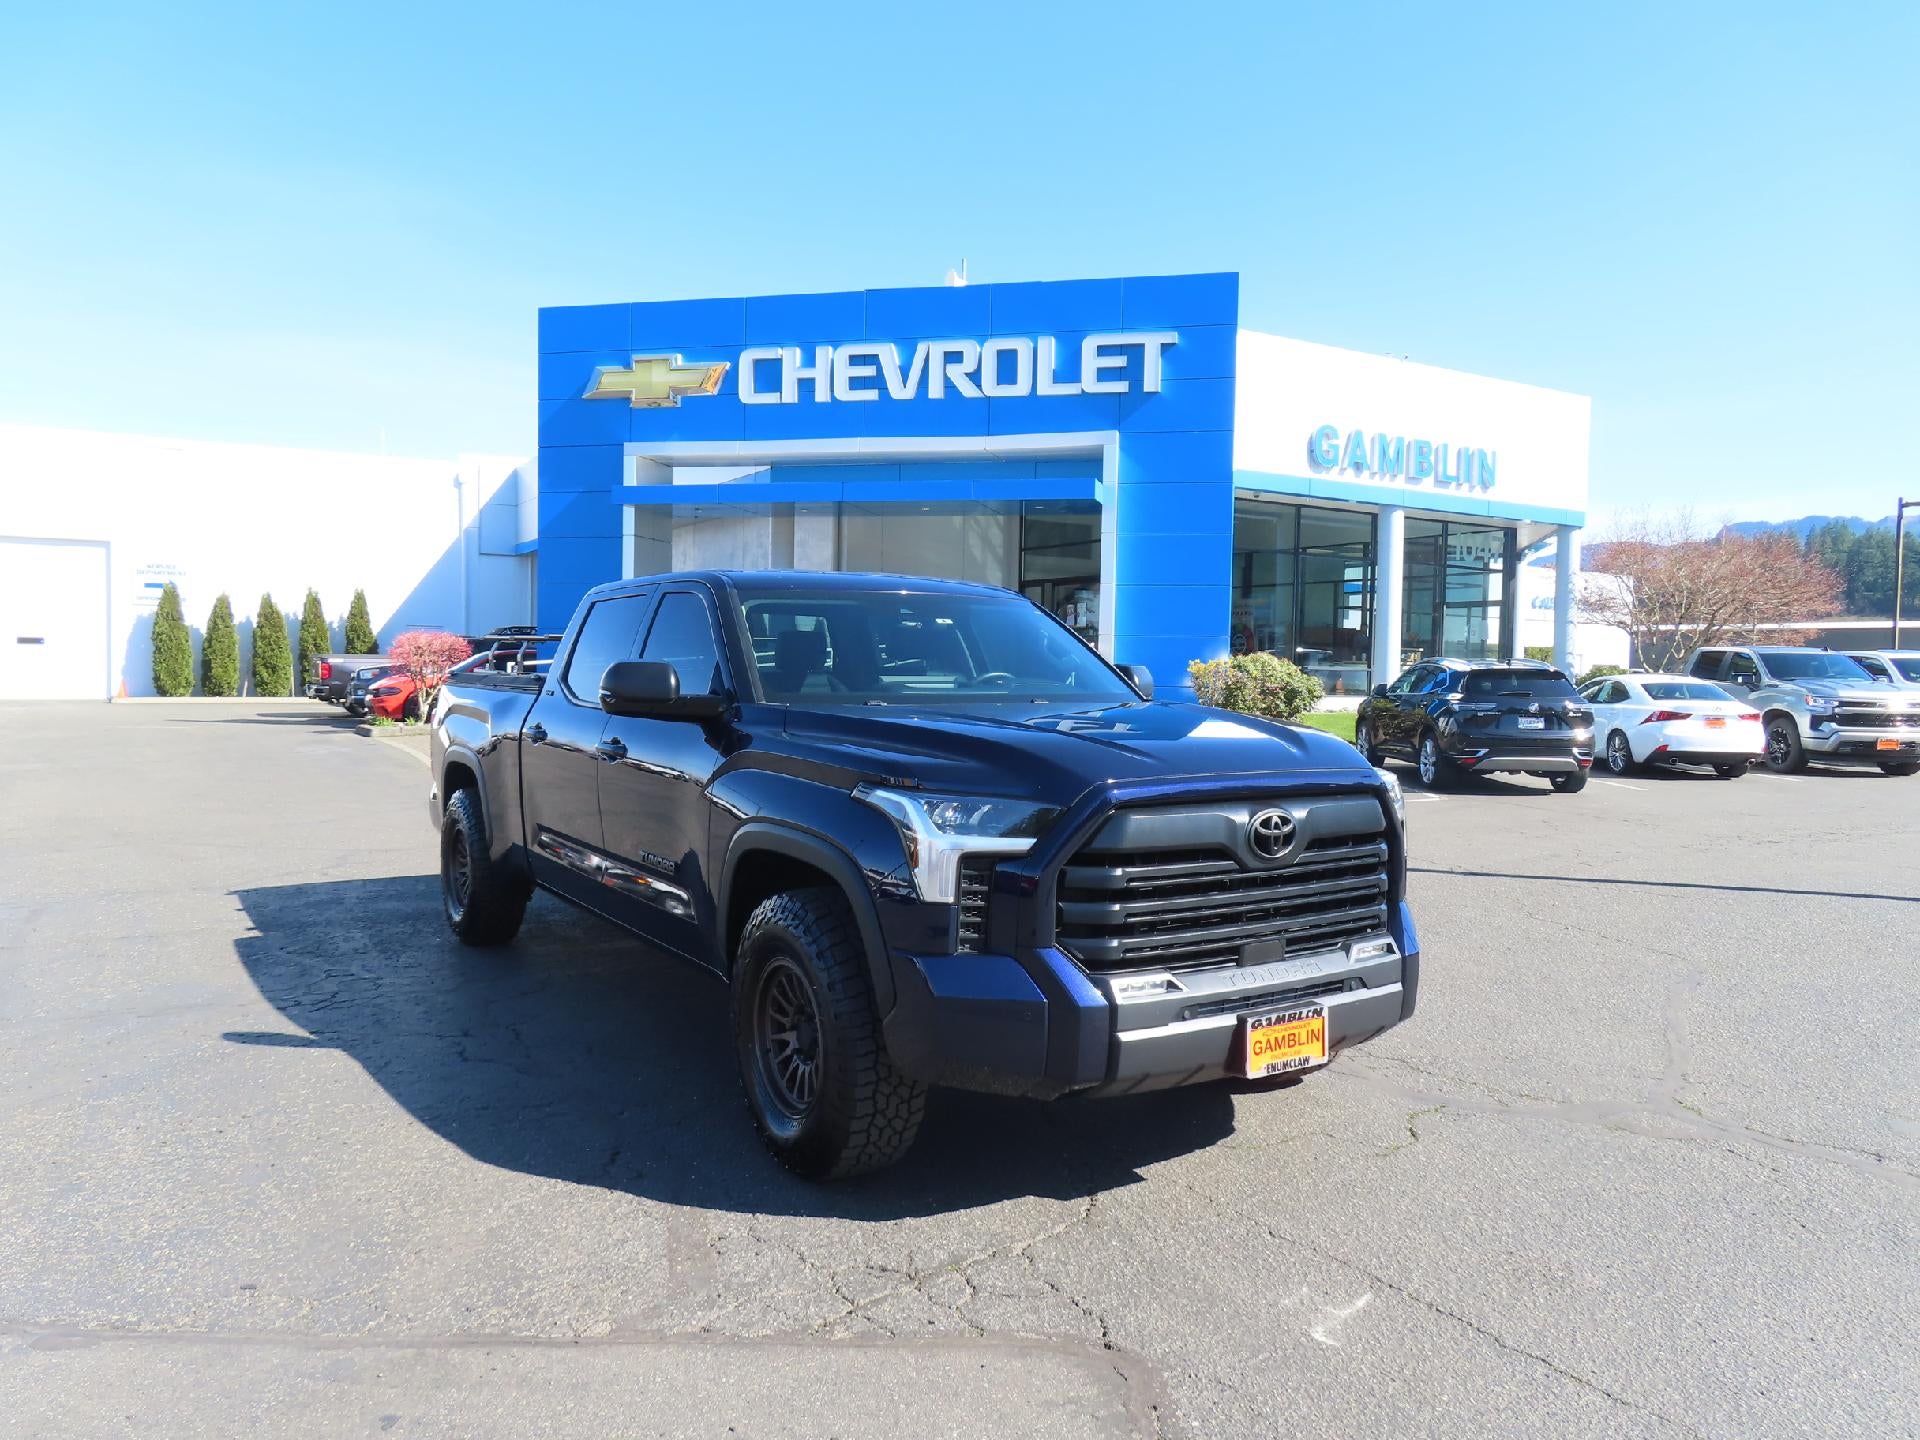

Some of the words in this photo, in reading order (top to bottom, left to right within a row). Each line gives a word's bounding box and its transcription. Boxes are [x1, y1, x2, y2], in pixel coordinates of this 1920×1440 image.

[738, 331, 1179, 404] CHEVROLET
[1309, 425, 1497, 489] GAMBLIN
[1252, 1028, 1321, 1056] GAMBLIN
[1265, 1055, 1311, 1074] ENUMCLAW
